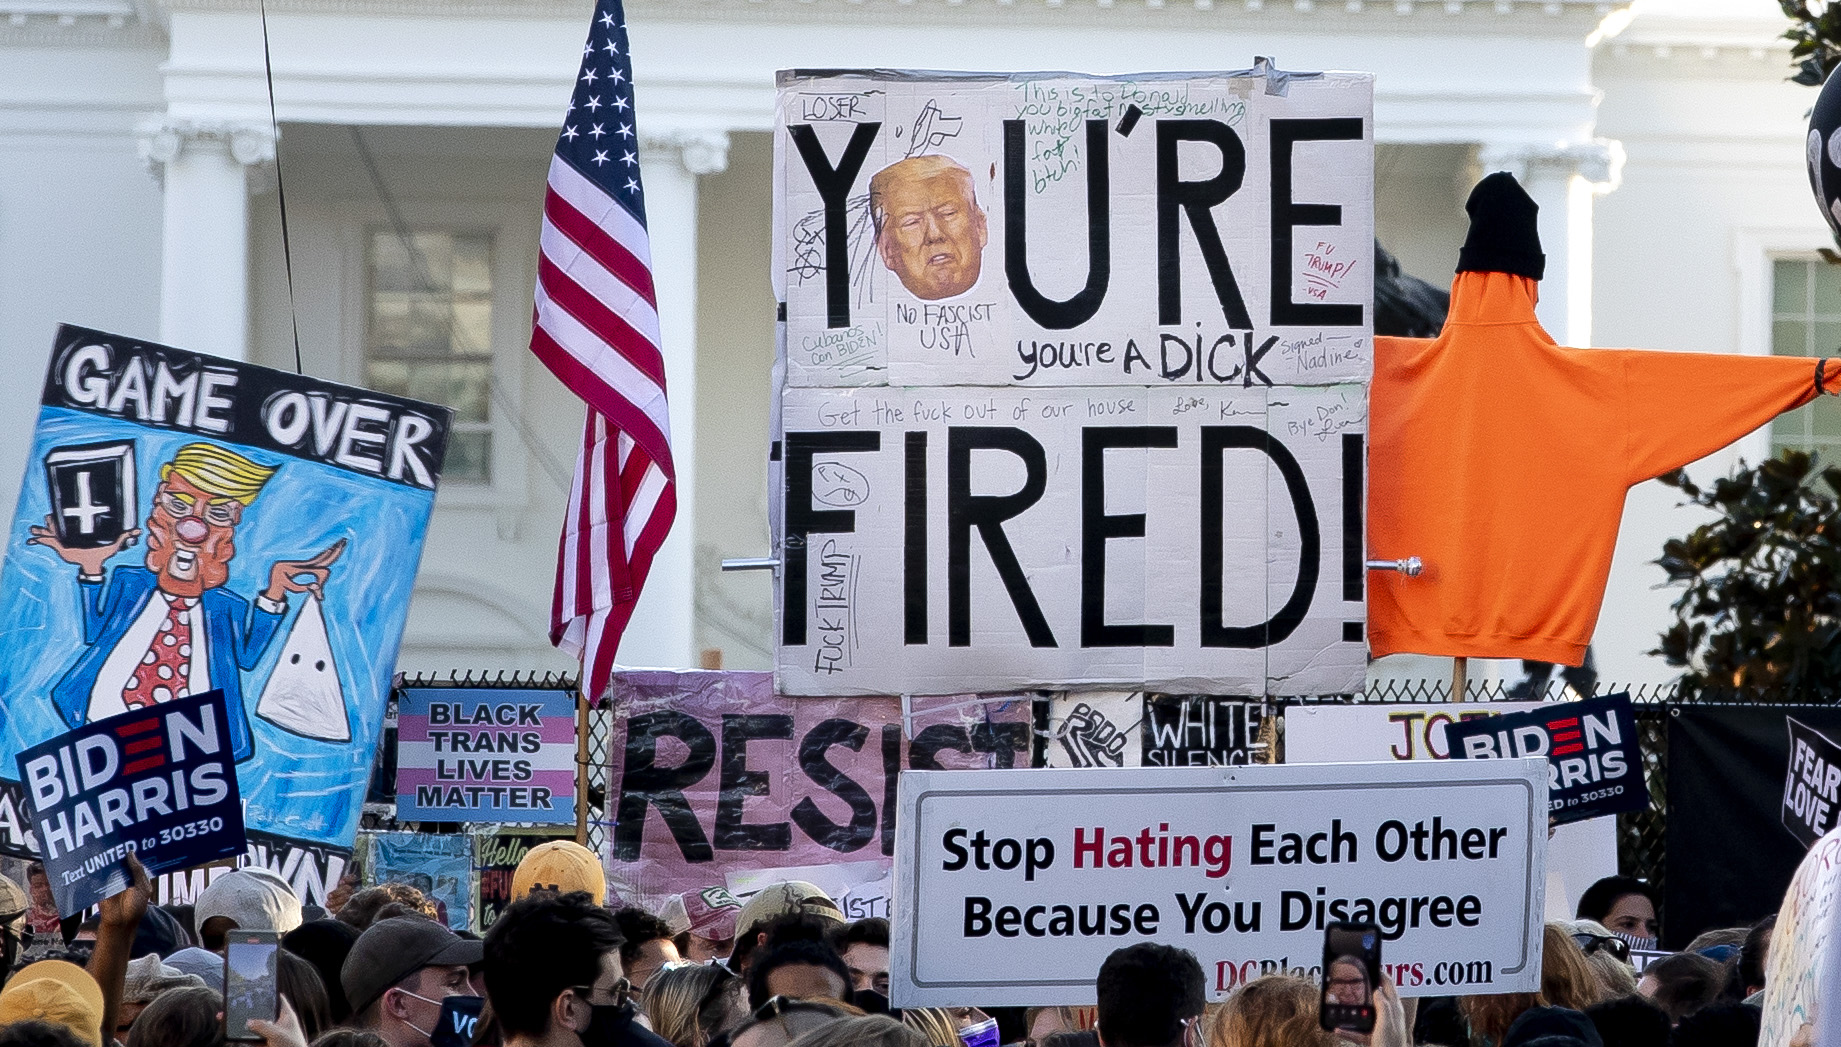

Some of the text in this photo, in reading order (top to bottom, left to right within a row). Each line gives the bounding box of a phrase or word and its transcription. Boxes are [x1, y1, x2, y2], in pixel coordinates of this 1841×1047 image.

[803, 96, 866, 121] LOSER
[1014, 80, 1188, 103] This is to Donald
[1013, 102, 1051, 121] you
[1056, 101, 1083, 132] big
[1083, 99, 1114, 118] fat
[1118, 102, 1176, 118] nsty
[1028, 117, 1073, 139] white
[896, 303, 997, 326] NO FASCIST
[802, 324, 865, 352] Cubanos
[920, 321, 975, 359] USA
[1012, 339, 1115, 381] you're
[1123, 338, 1151, 374] A
[62, 343, 438, 489] GAME OVER
[818, 397, 1136, 427] Get the fuck out of our house
[1287, 418, 1315, 436] Bye
[782, 424, 1364, 648] FIRED!
[814, 538, 850, 675] FUCK TRUMP
[427, 701, 544, 727] BLACK
[1147, 700, 1269, 749] WHITE
[426, 731, 541, 755] TRANS
[1463, 710, 1622, 759] BIDEN
[25, 703, 220, 813] BIDEN
[436, 759, 533, 782] LIVES
[40, 762, 228, 860] HARRIS
[415, 786, 552, 809] MATTER
[1581, 785, 1624, 803] 30330
[1785, 772, 1830, 837] LOVE
[61, 867, 85, 885] Text
[85, 840, 138, 874] UNITED
[142, 837, 156, 851] to
[159, 816, 223, 845] 30330
[942, 815, 1508, 882] Stop Hating Each Other
[963, 886, 1482, 942] Because You Disagree
